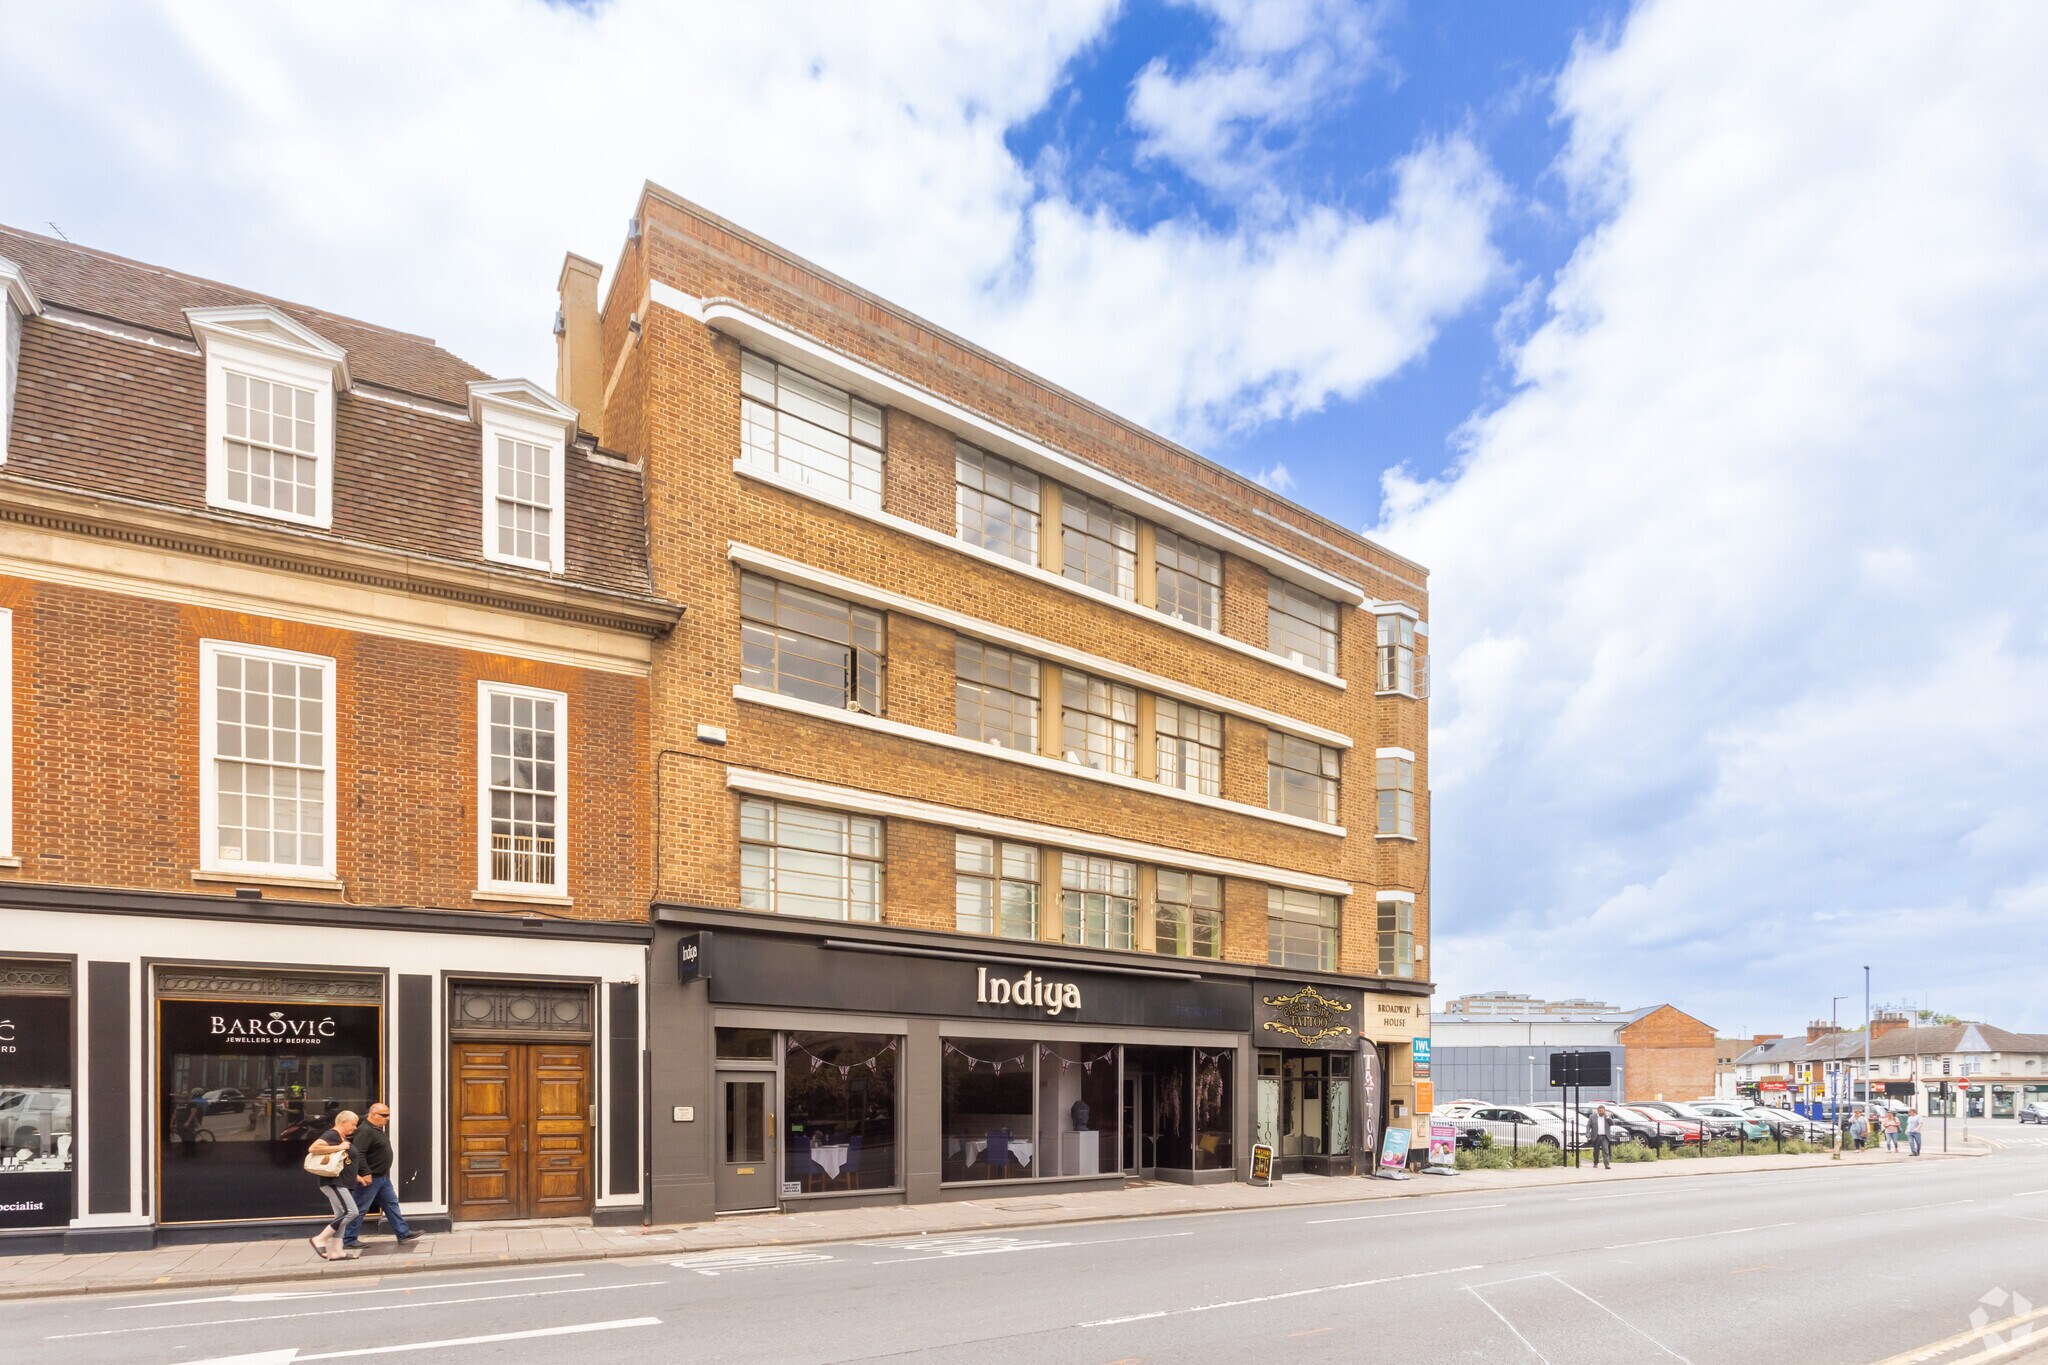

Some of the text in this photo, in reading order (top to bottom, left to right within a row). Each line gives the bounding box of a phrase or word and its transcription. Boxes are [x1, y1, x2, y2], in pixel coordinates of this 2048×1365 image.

[977, 967, 1081, 1016] Indiya
[1378, 1004, 1411, 1014] BROADWAY
[1290, 1015, 1328, 1027] TATTOO
[1383, 1018, 1406, 1027] HOUSE
[1362, 1054, 1375, 1149] TATTOO
